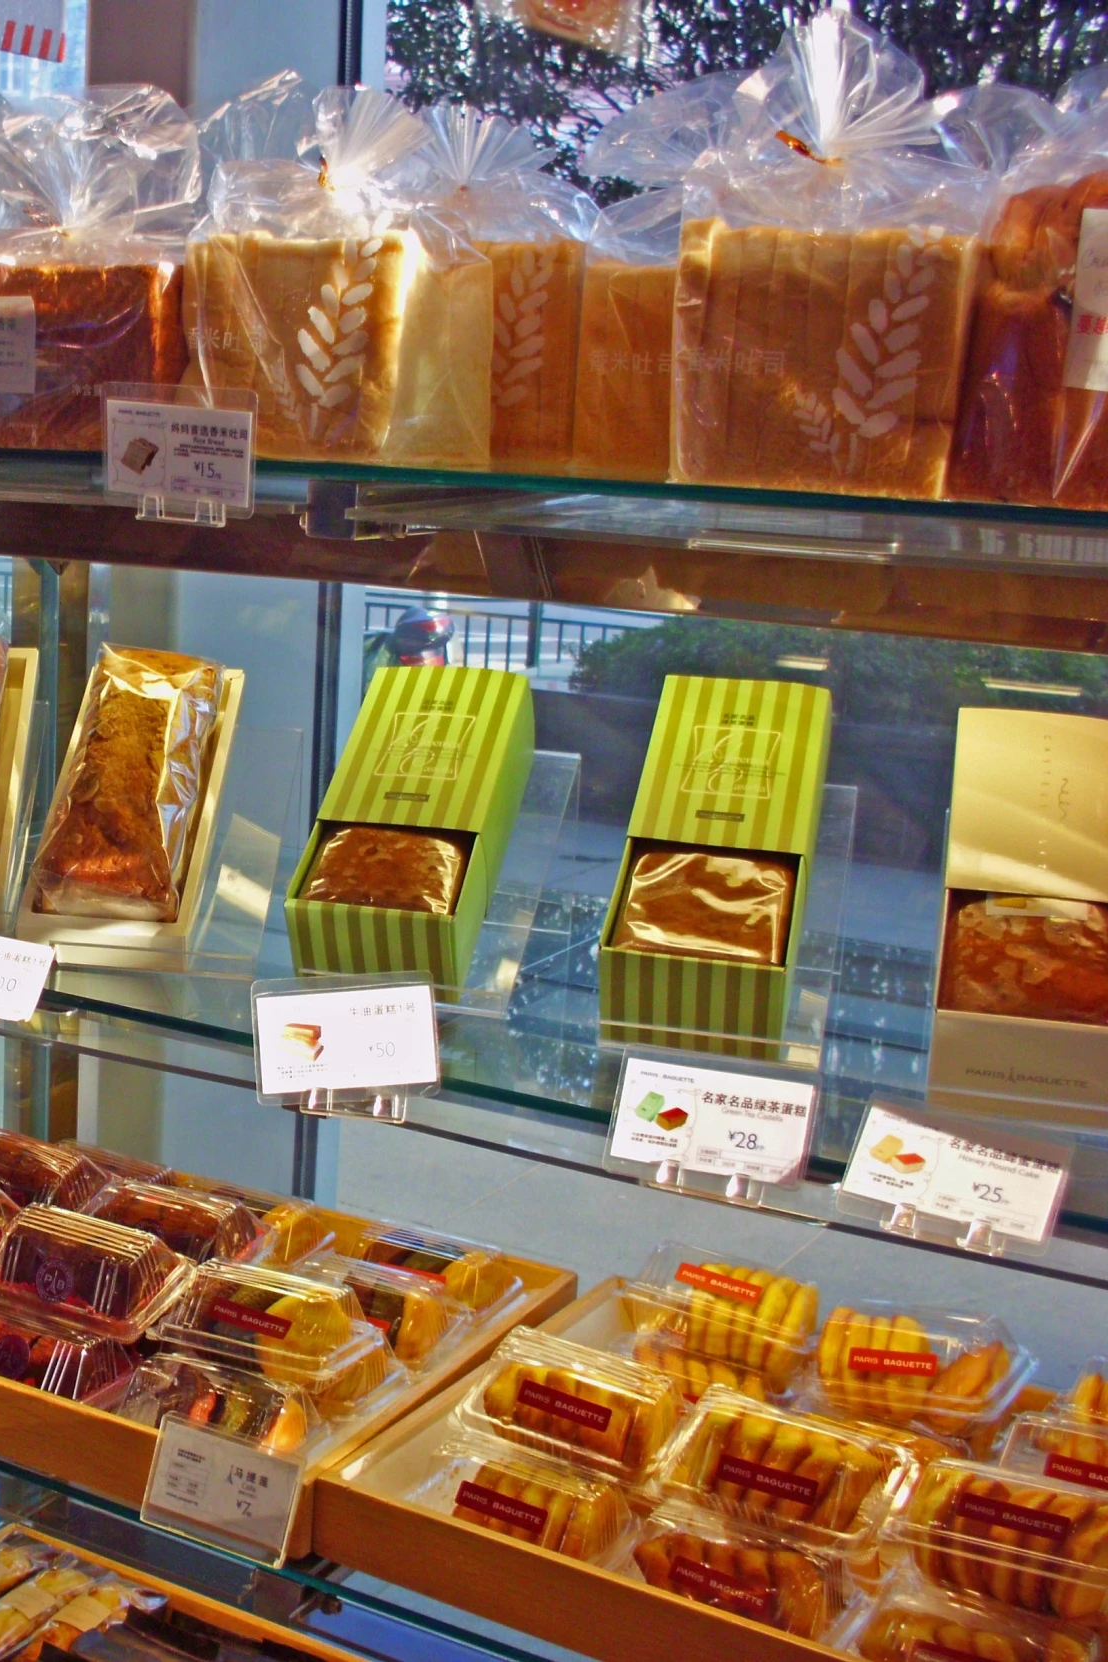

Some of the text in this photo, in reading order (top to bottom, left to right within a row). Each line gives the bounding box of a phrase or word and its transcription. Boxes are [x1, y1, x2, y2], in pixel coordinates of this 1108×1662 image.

[369, 1041, 396, 1058] ¥50
[662, 1074, 696, 1084] BAGUETTE
[965, 1067, 1090, 1089] PARIS BAGUETTE
[701, 1091, 808, 1118] 名家名品绿茶蛋糕
[721, 1106, 744, 1117] Green
[746, 1109, 757, 1119] Tea
[949, 1136, 1061, 1175] 名家名品蜂蜜蛋糕
[959, 1153, 1040, 1180] Honey Pound Cake
[682, 1270, 756, 1298] PARIS BAGUETTE
[214, 1304, 285, 1333] PARIS BAGUETTE
[853, 1355, 932, 1370] PARIS BAGUETTE
[524, 1388, 606, 1424] PARIS BAGUETTE
[723, 1464, 812, 1497] PARIS BAGUETTE
[1052, 1462, 1083, 1477] PARIS
[462, 1489, 542, 1525] PARIS BAGUETTE
[964, 1502, 1062, 1534] PARIS BAGUETTE
[676, 1566, 764, 1607] PARIS BAGUETTE
